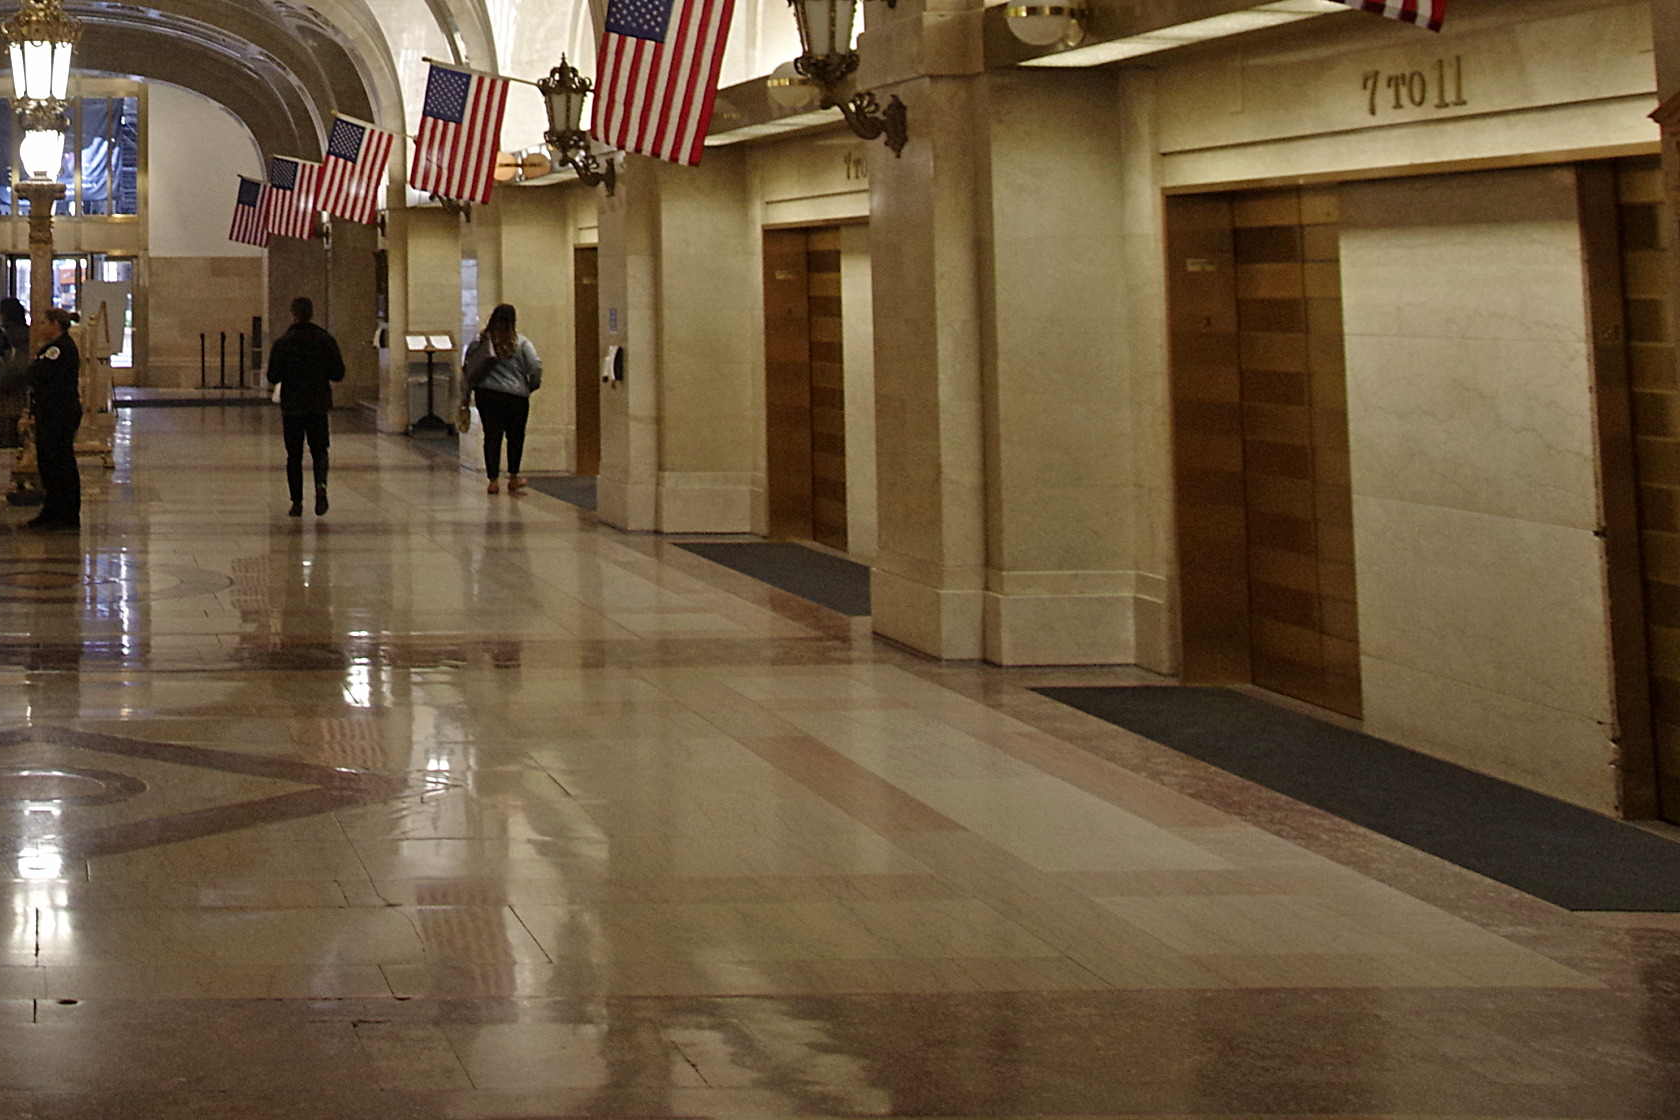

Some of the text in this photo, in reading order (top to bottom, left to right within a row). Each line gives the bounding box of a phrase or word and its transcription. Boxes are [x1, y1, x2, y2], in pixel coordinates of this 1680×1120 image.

[1362, 55, 1468, 116] 7 TO 11
